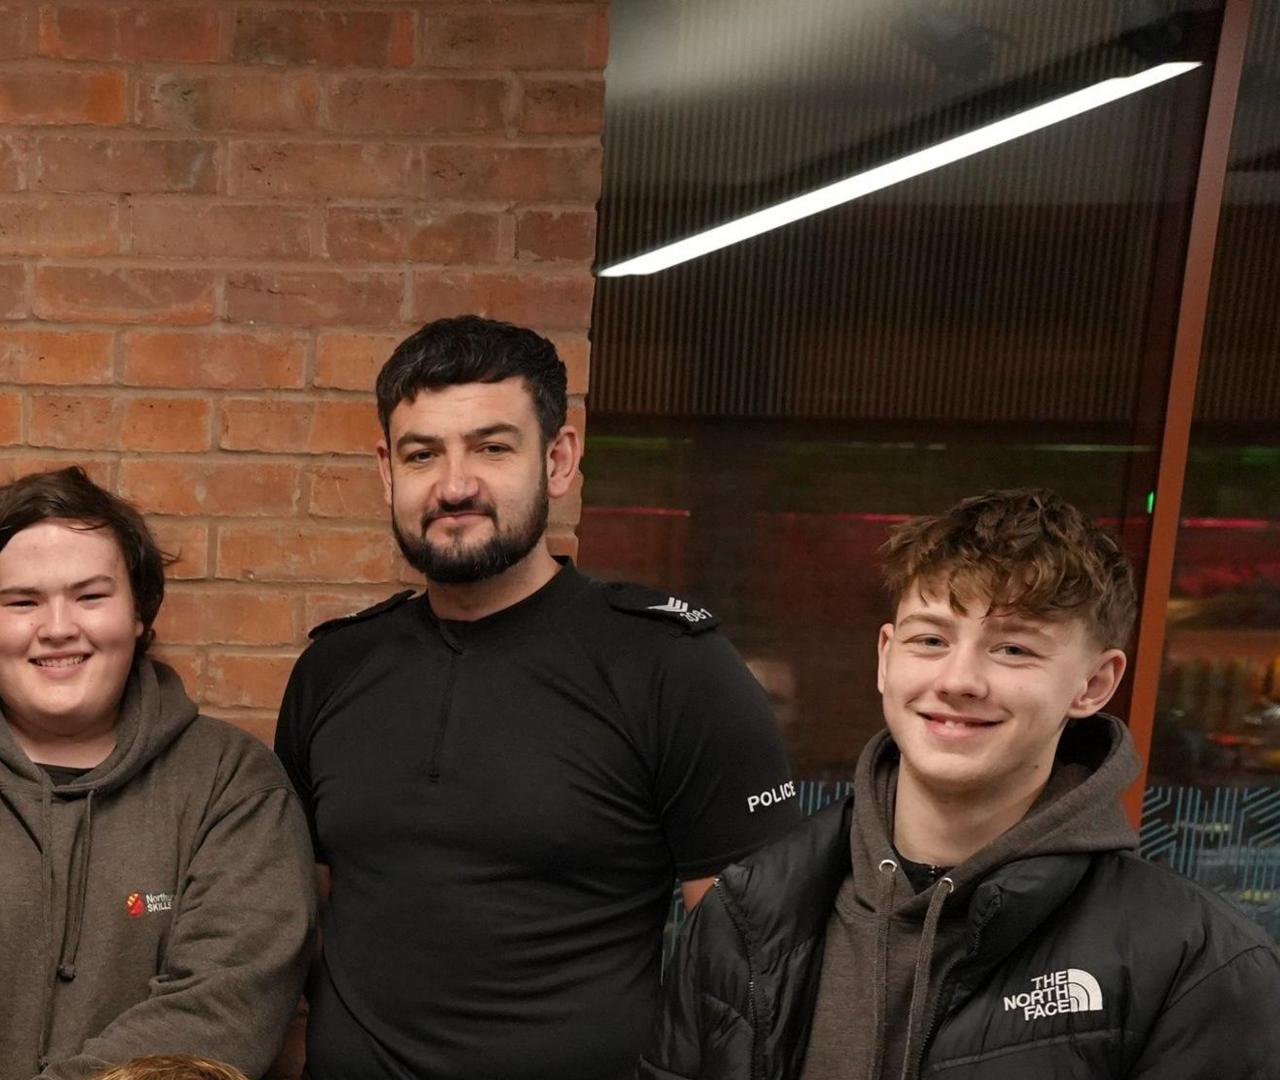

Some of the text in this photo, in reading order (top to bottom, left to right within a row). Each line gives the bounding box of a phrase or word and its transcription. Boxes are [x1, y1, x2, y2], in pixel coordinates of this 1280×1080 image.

[747, 781, 796, 812] POLICE
[1031, 970, 1067, 989] THE
[1003, 981, 1069, 1011] NORTH
[1024, 999, 1071, 1021] FACE
